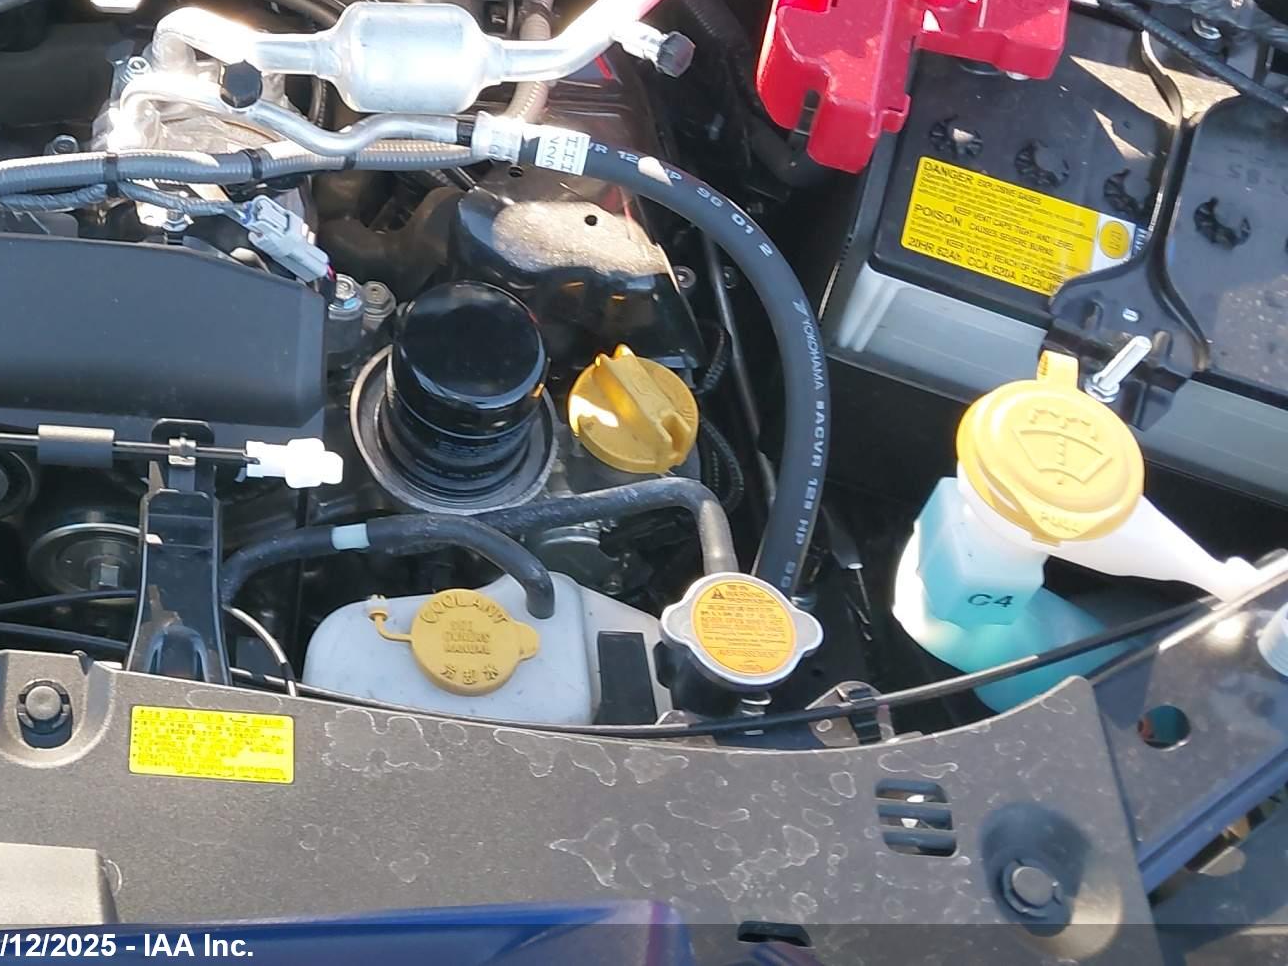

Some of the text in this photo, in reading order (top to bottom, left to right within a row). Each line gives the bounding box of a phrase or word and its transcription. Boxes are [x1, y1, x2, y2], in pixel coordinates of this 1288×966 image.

[923, 161, 973, 185] DANGER
[914, 204, 961, 227] POISON
[1032, 267, 1065, 284] CHILDRE
[802, 318, 825, 390] YOKOHAMA
[420, 594, 508, 624] COOLANT
